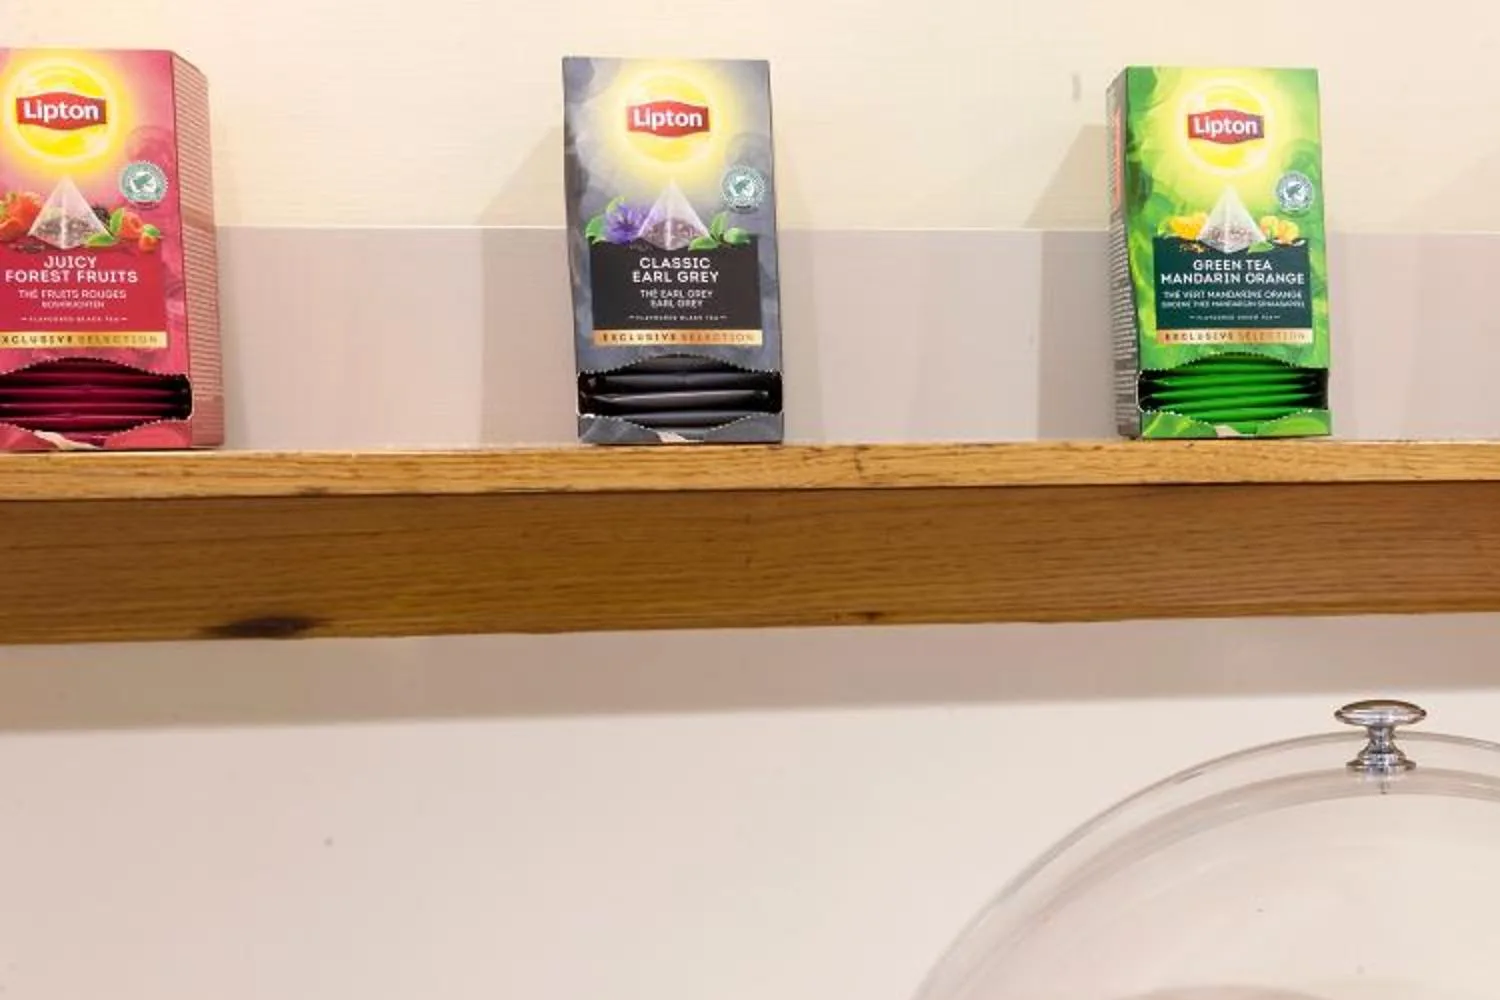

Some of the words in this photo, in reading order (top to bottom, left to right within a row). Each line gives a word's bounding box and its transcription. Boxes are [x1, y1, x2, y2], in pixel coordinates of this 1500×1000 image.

[23, 100, 99, 123] Lipton
[633, 108, 703, 130] Lipton
[1193, 117, 1258, 137] Lipton
[43, 255, 97, 269] JUICY
[639, 257, 711, 269] CLASSIC
[1193, 259, 1241, 271] GREEN
[1245, 259, 1272, 271] TEA
[5, 269, 71, 283] FOREST
[77, 270, 138, 283] FRUITS
[632, 271, 672, 283] EARL
[677, 271, 719, 283] GREY
[1161, 272, 1241, 285] MANDARIN
[1245, 273, 1305, 285] ORANGE
[0, 335, 73, 344] XCLUSIVE
